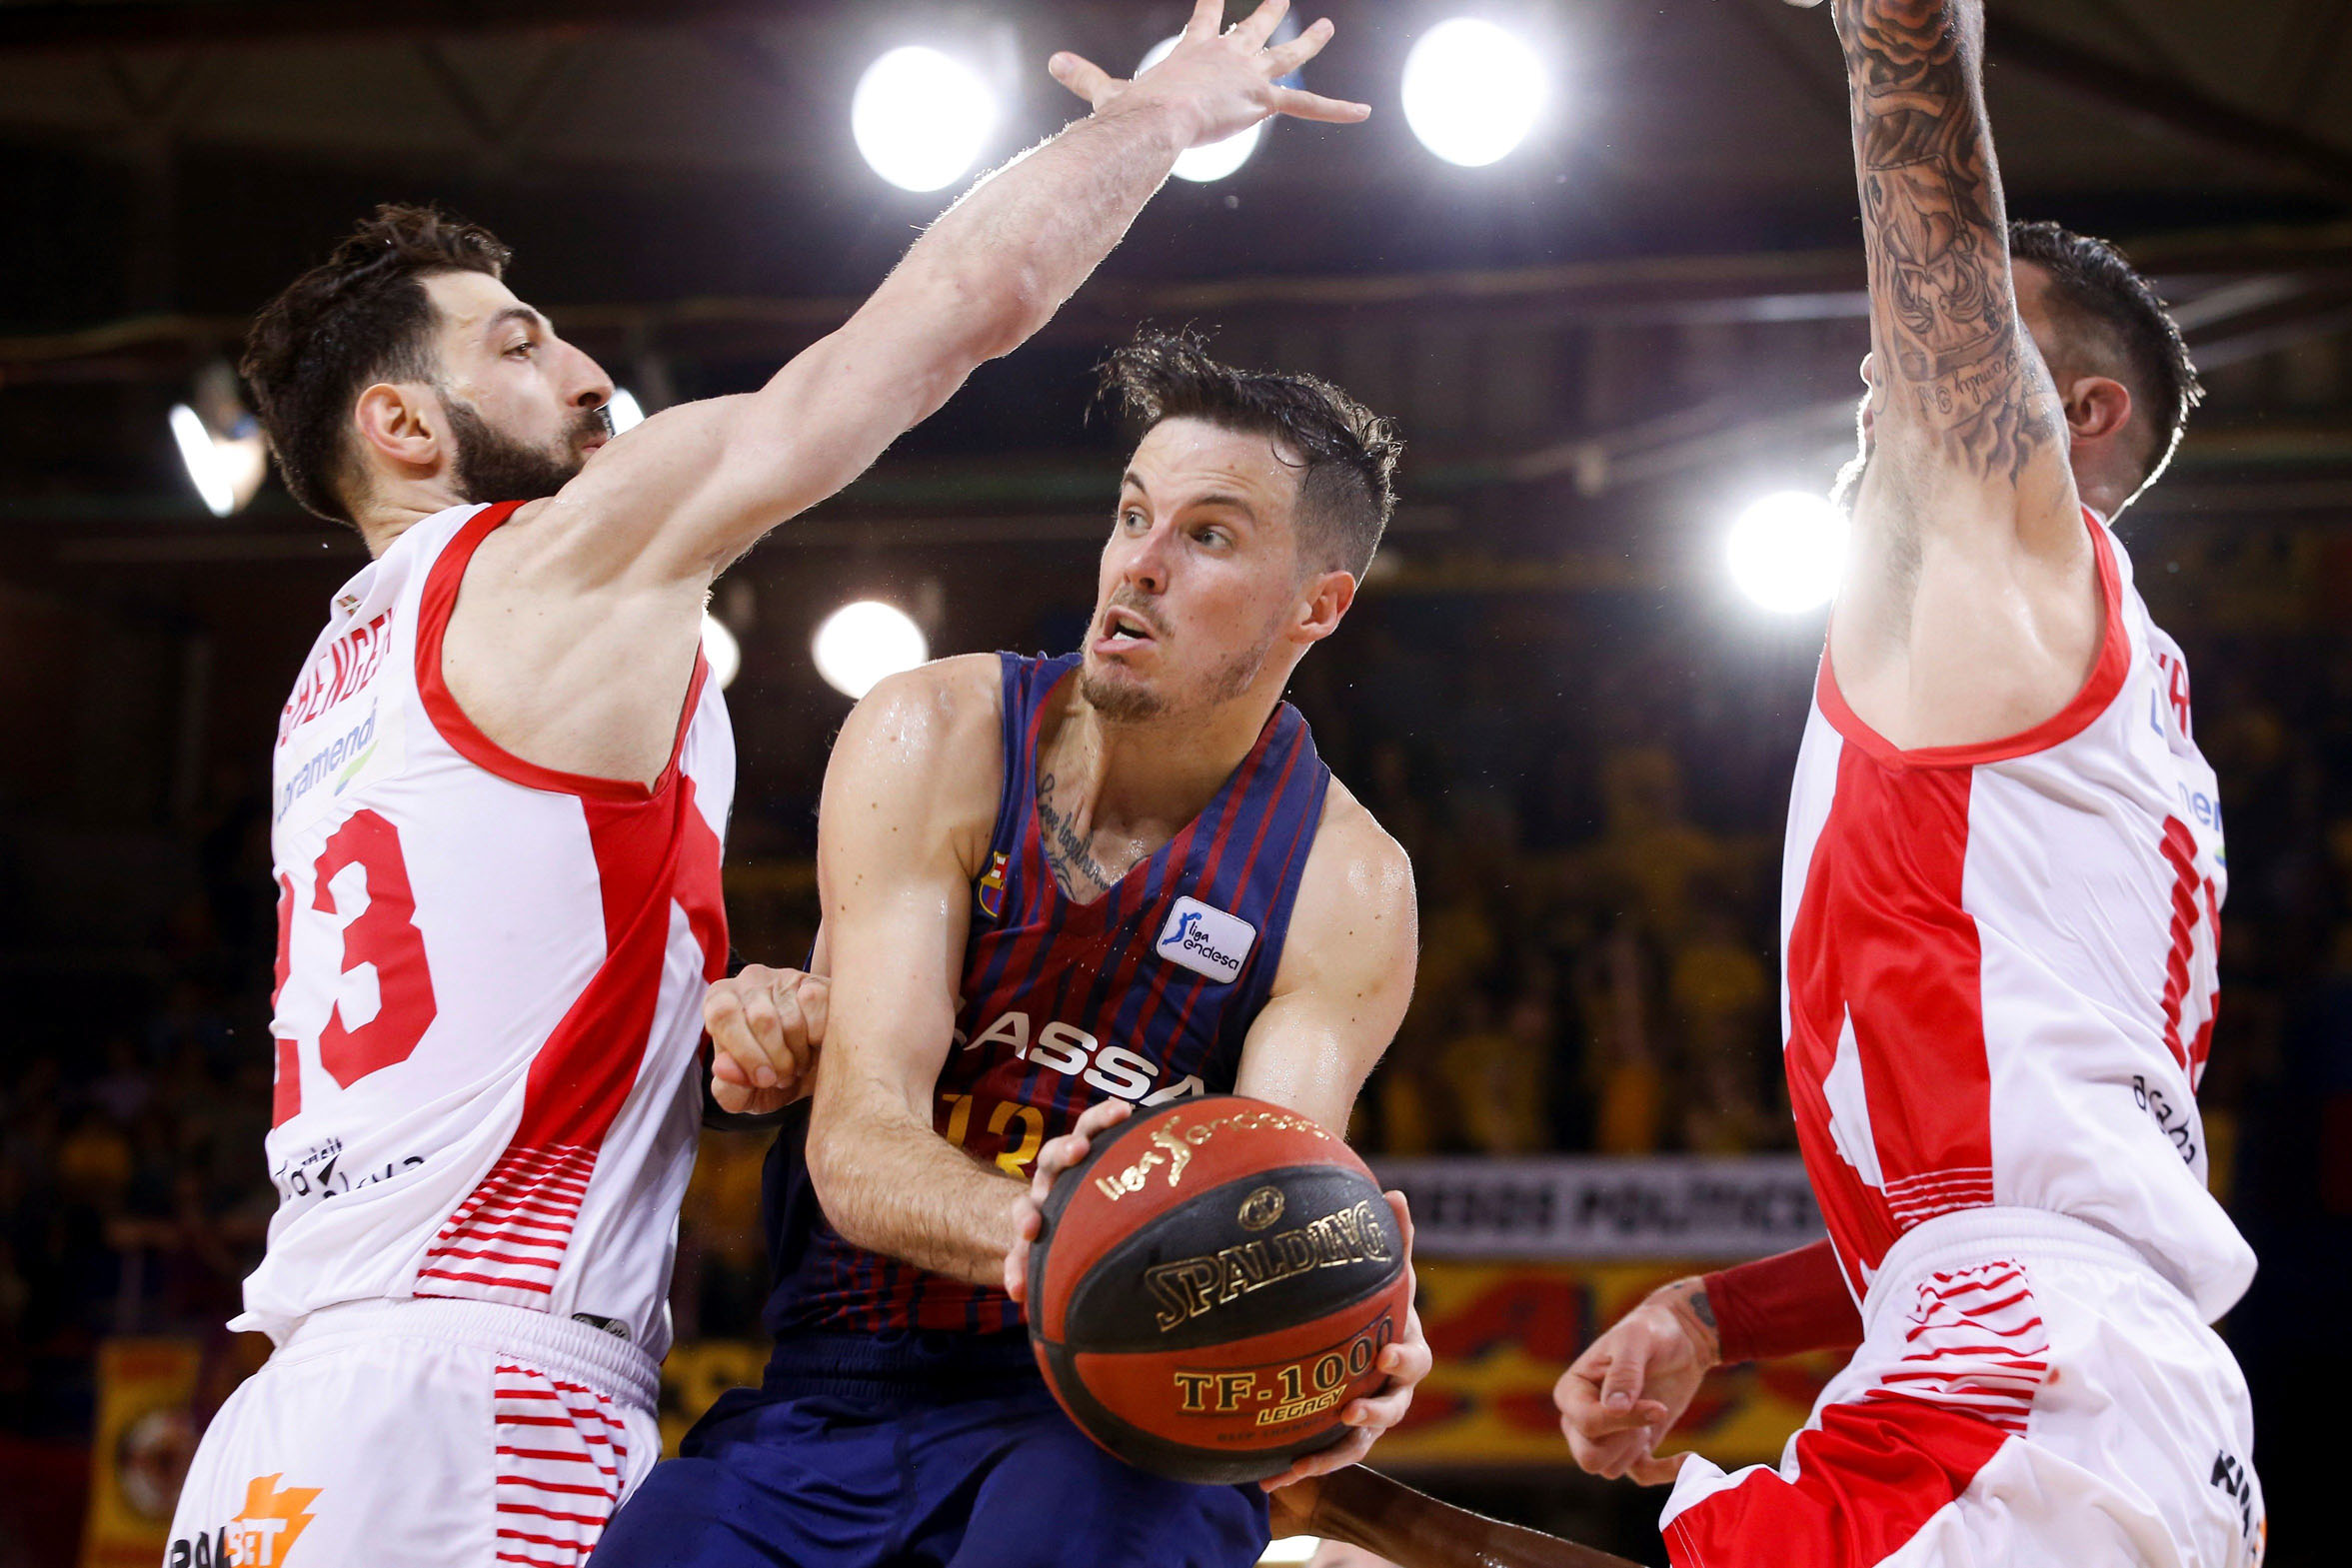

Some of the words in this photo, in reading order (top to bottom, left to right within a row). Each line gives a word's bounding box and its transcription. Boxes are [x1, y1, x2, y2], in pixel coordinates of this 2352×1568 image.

[1188, 920, 1209, 942] liga
[1183, 938, 1240, 970] endesa
[955, 1011, 1204, 1106] ASSA
[1145, 1199, 1392, 1332] SPALDING
[1255, 1384, 1346, 1426] LEGACY
